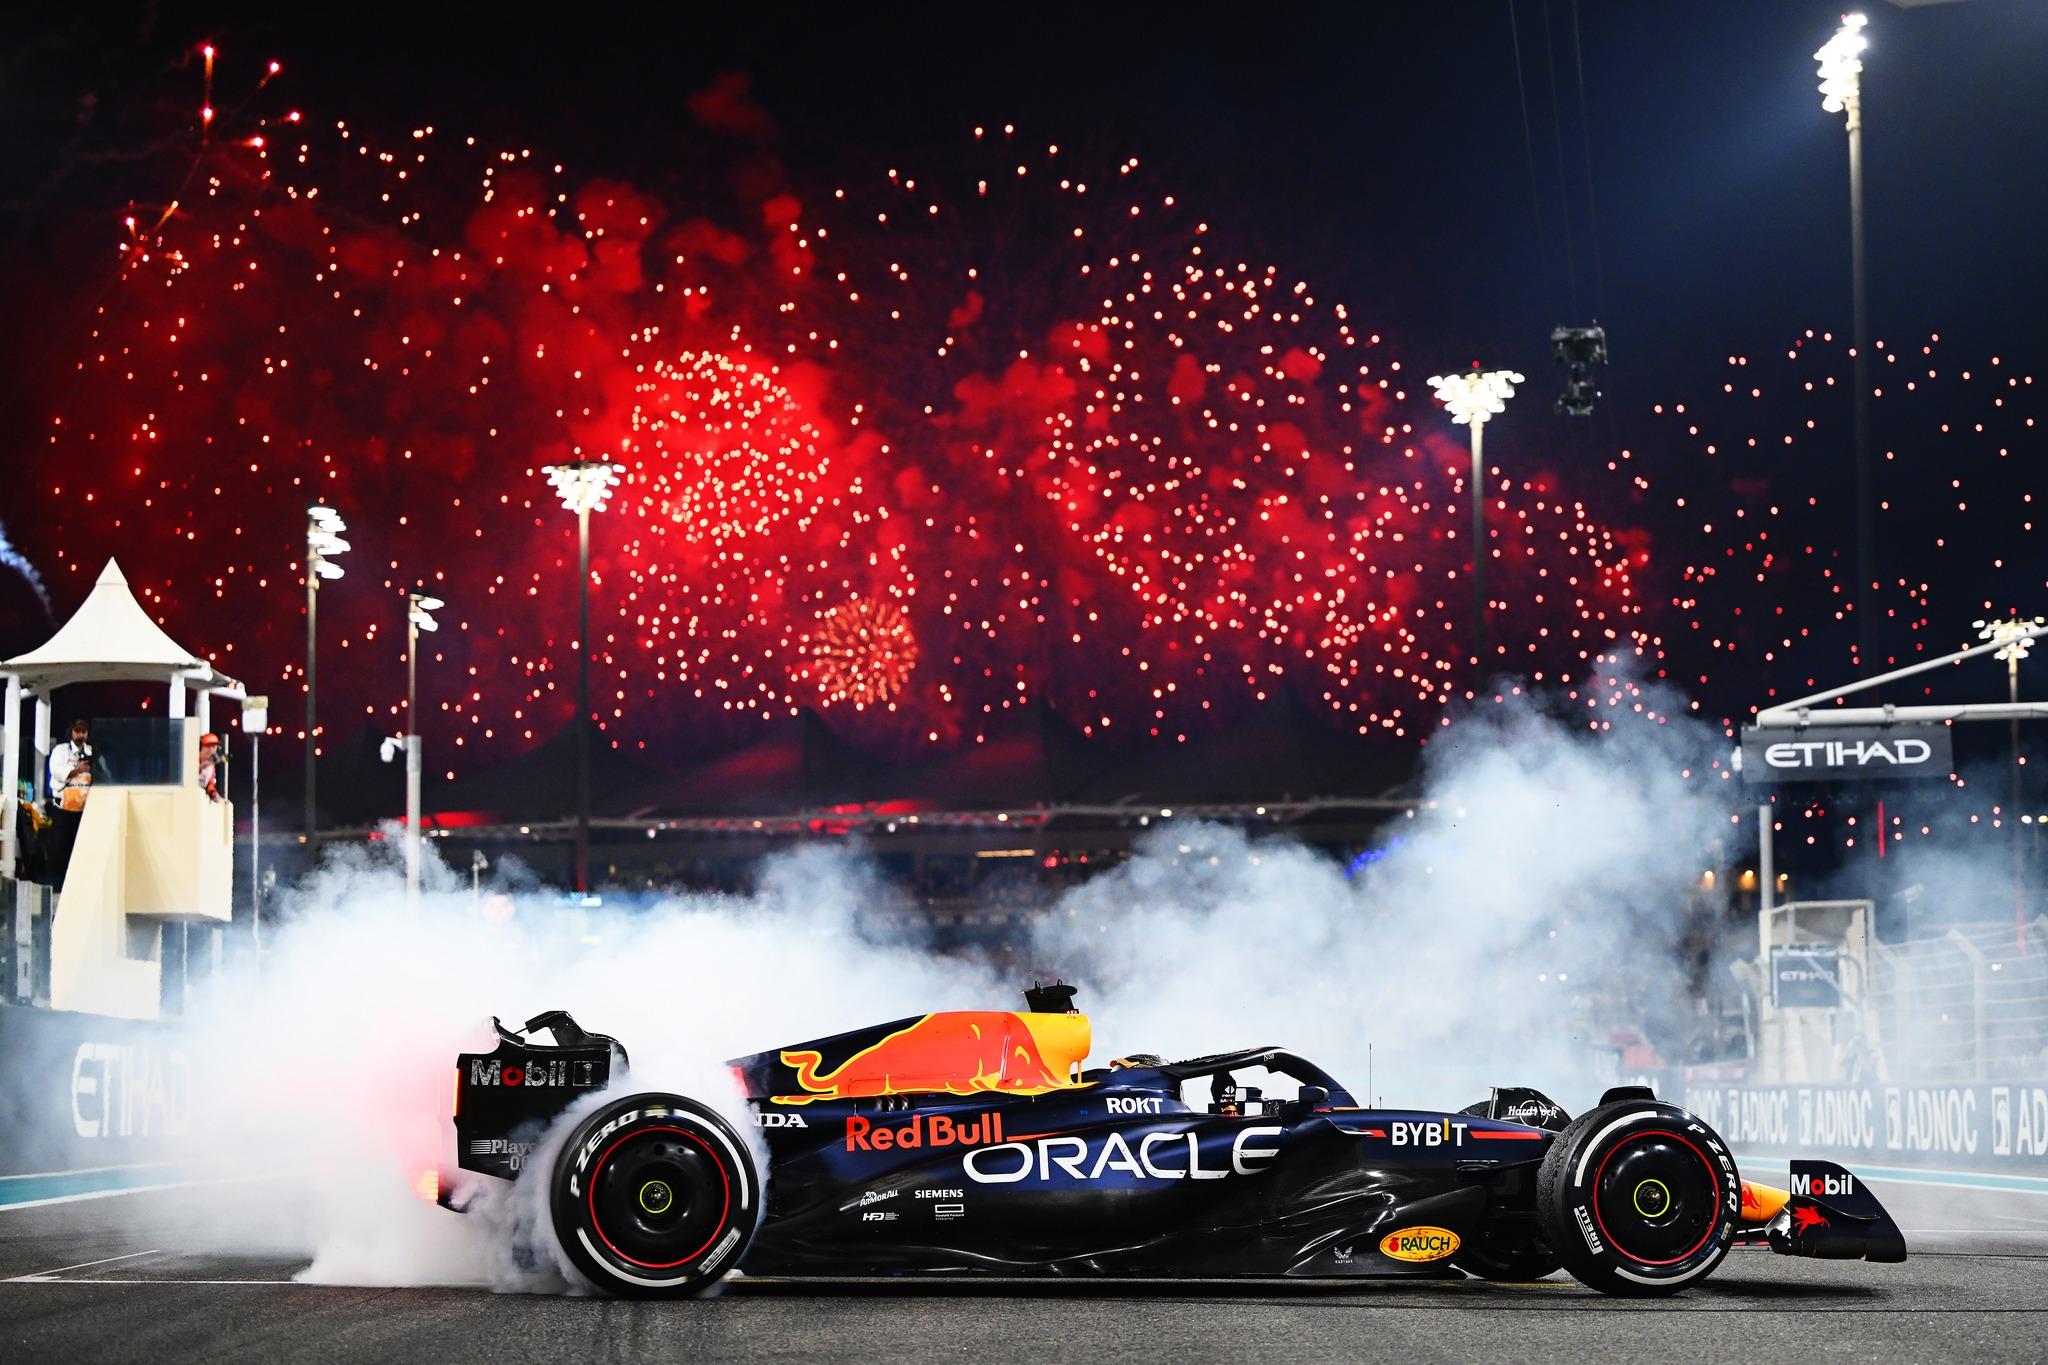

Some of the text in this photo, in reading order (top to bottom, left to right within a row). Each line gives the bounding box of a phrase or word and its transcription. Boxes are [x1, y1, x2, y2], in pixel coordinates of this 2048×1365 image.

[1765, 739, 1931, 767] ETIHAD
[72, 1042, 192, 1137] ETIHAD
[470, 1059, 566, 1086] Mobil
[1105, 1097, 1163, 1114] ROKT
[1741, 1089, 1788, 1144] ADNOC
[1815, 1089, 1874, 1149] ADNOC
[1907, 1088, 1977, 1154] ADNOC
[846, 1112, 1002, 1152] Red Bull
[1391, 1118, 1467, 1147] BYBIT
[570, 1110, 639, 1198] P ZERO
[963, 1126, 1282, 1184] ORACLE
[1687, 1123, 1706, 1134] P
[1706, 1138, 1738, 1213] ZERO
[914, 1189, 964, 1199] SIEMENS
[1791, 1174, 1853, 1196] Mobil
[1400, 1236, 1451, 1251] RAUCH
